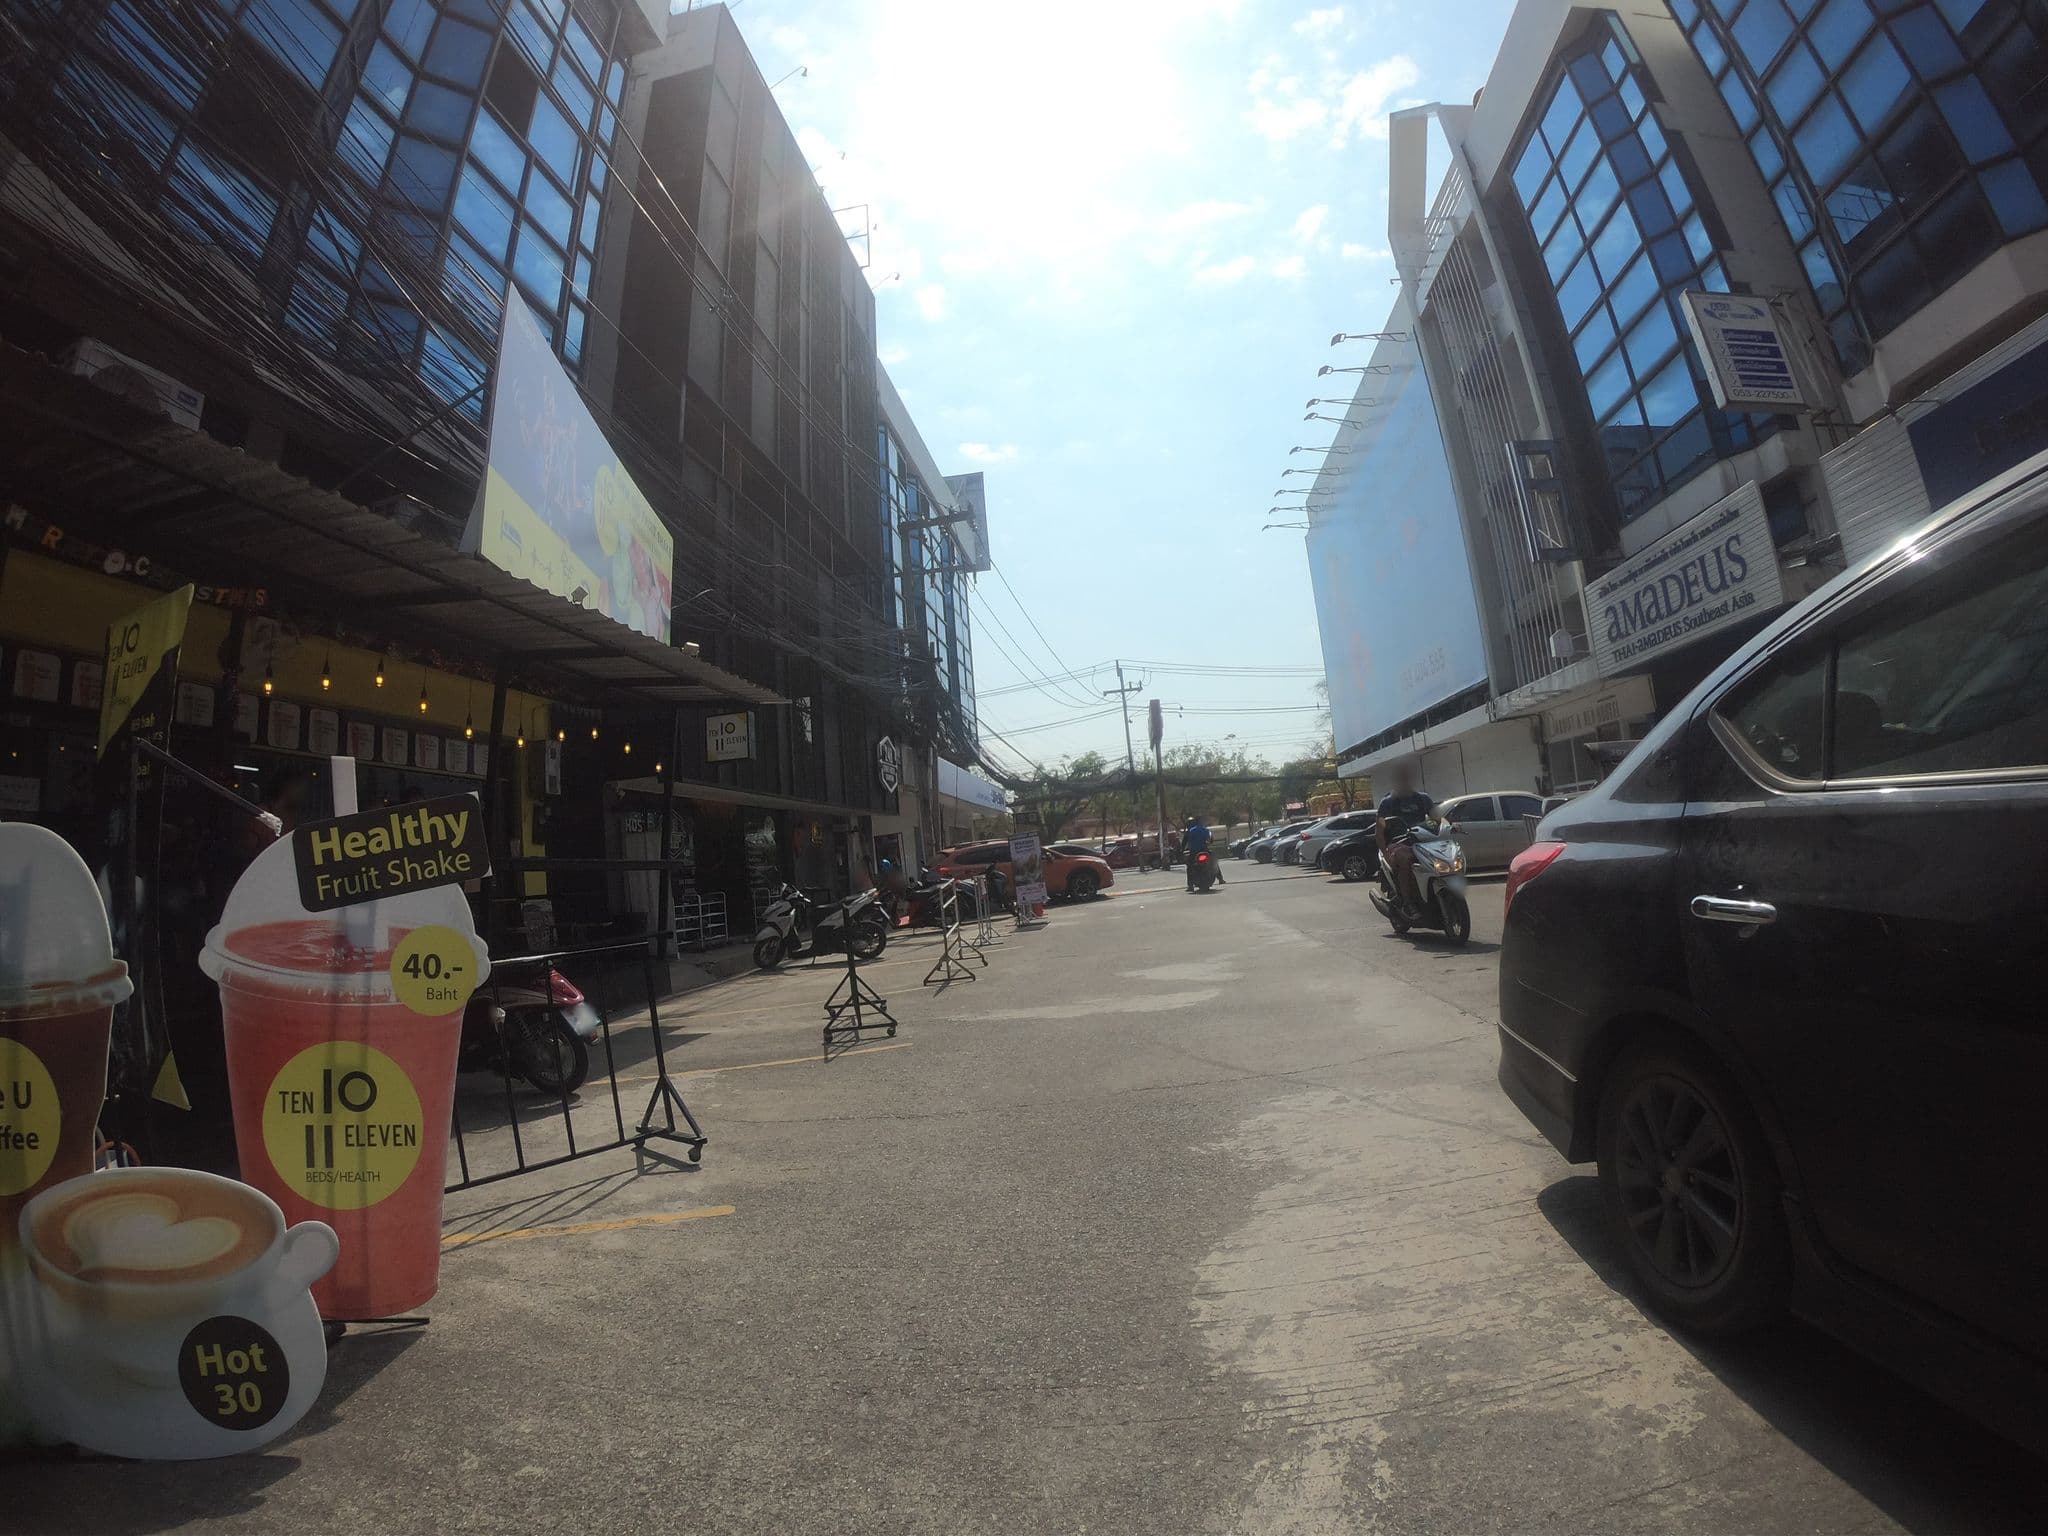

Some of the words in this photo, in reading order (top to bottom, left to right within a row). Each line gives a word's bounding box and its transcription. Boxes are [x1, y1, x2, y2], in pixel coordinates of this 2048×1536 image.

[1683, 599, 1730, 632] Southeast
[1733, 590, 1756, 612] Asia
[310, 807, 469, 866] Healthy
[316, 866, 382, 901] Fruit
[387, 850, 471, 886] Shake
[402, 953, 463, 980] 40.-
[426, 987, 458, 1001] Baht
[13, 1080, 32, 1110] U
[279, 1091, 314, 1114] TEN
[345, 1125, 416, 1147] ELEVEN
[306, 1171, 381, 1183] BEDS/HEALTH
[195, 1343, 268, 1377] Hot
[214, 1381, 262, 1415] 30
